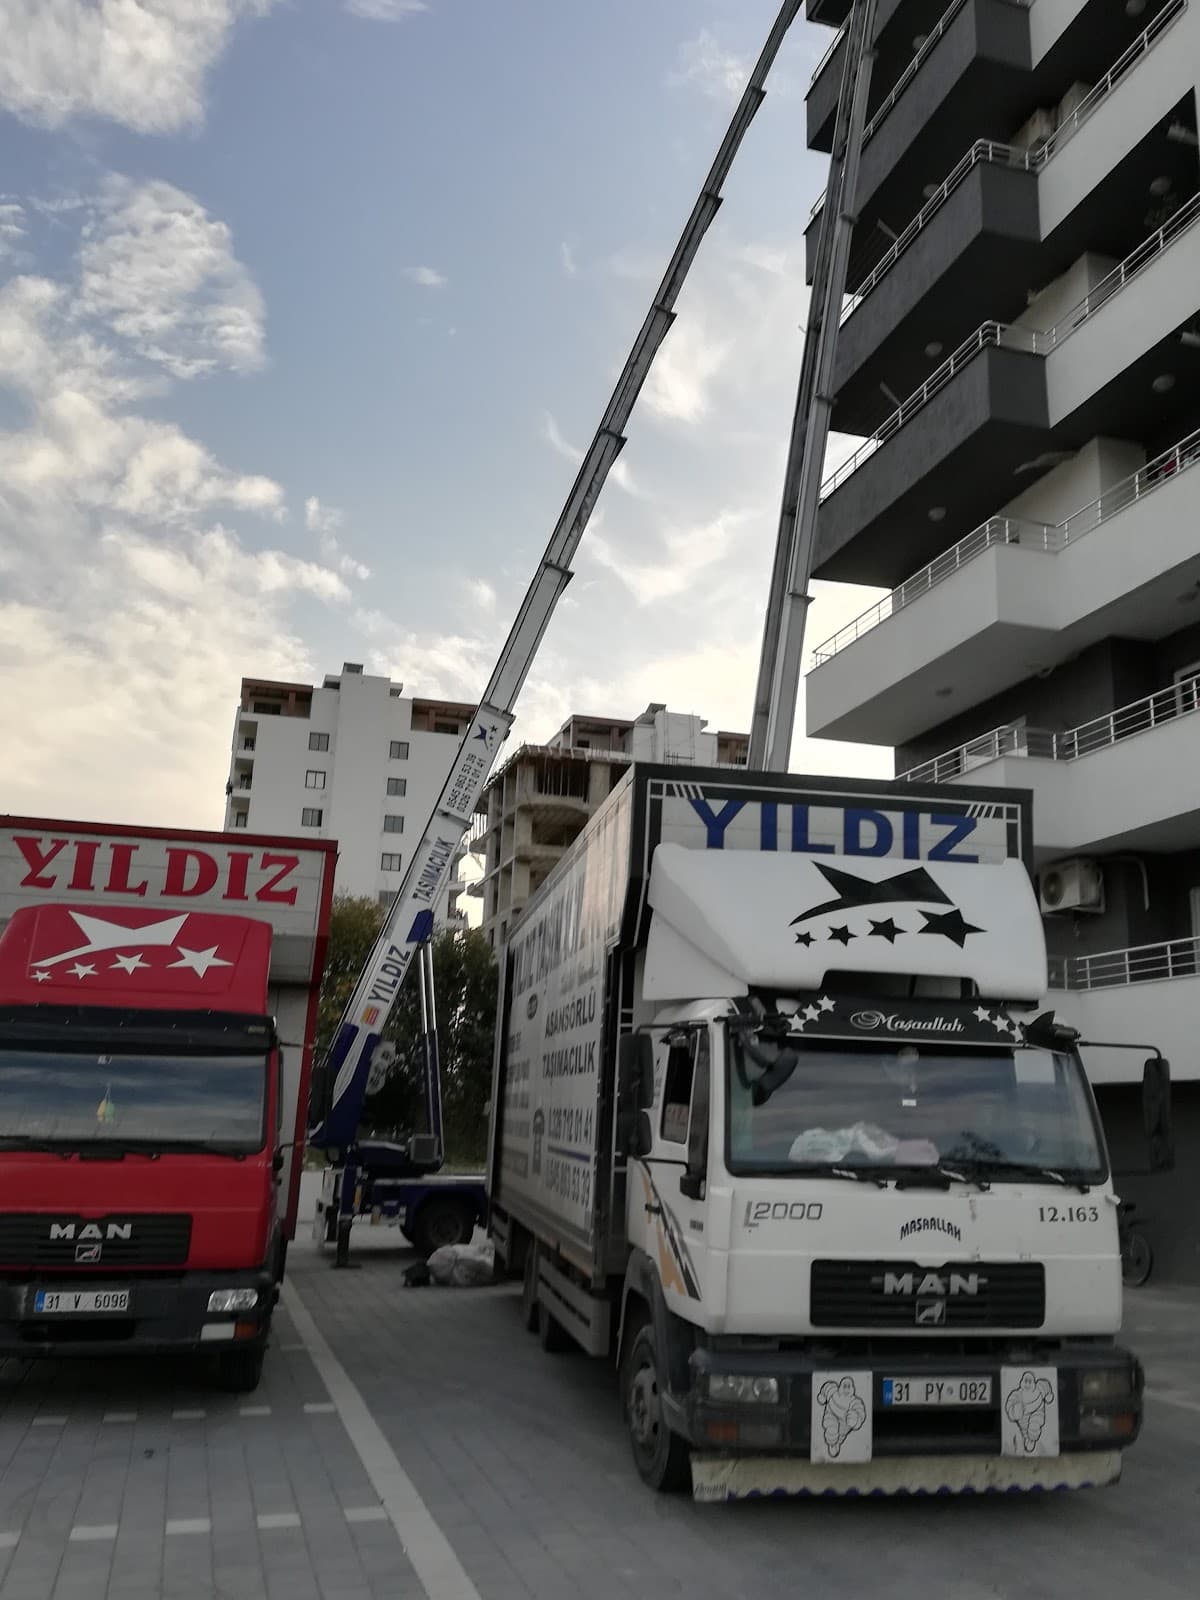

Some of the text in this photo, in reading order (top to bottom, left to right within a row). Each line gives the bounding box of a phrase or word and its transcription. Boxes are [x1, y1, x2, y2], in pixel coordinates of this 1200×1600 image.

[688, 799, 979, 864] YILDIZ
[12, 836, 300, 906] YILDIZ
[368, 945, 411, 1003] YILDIZ
[1039, 1206, 1099, 1222] 12.163
[50, 1223, 132, 1239] MAN
[884, 1272, 979, 1296] MAN
[46, 1293, 127, 1309] 31 V 6098
[894, 1382, 910, 1402] 31
[925, 1382, 945, 1402] PY
[959, 1382, 987, 1402] 082
